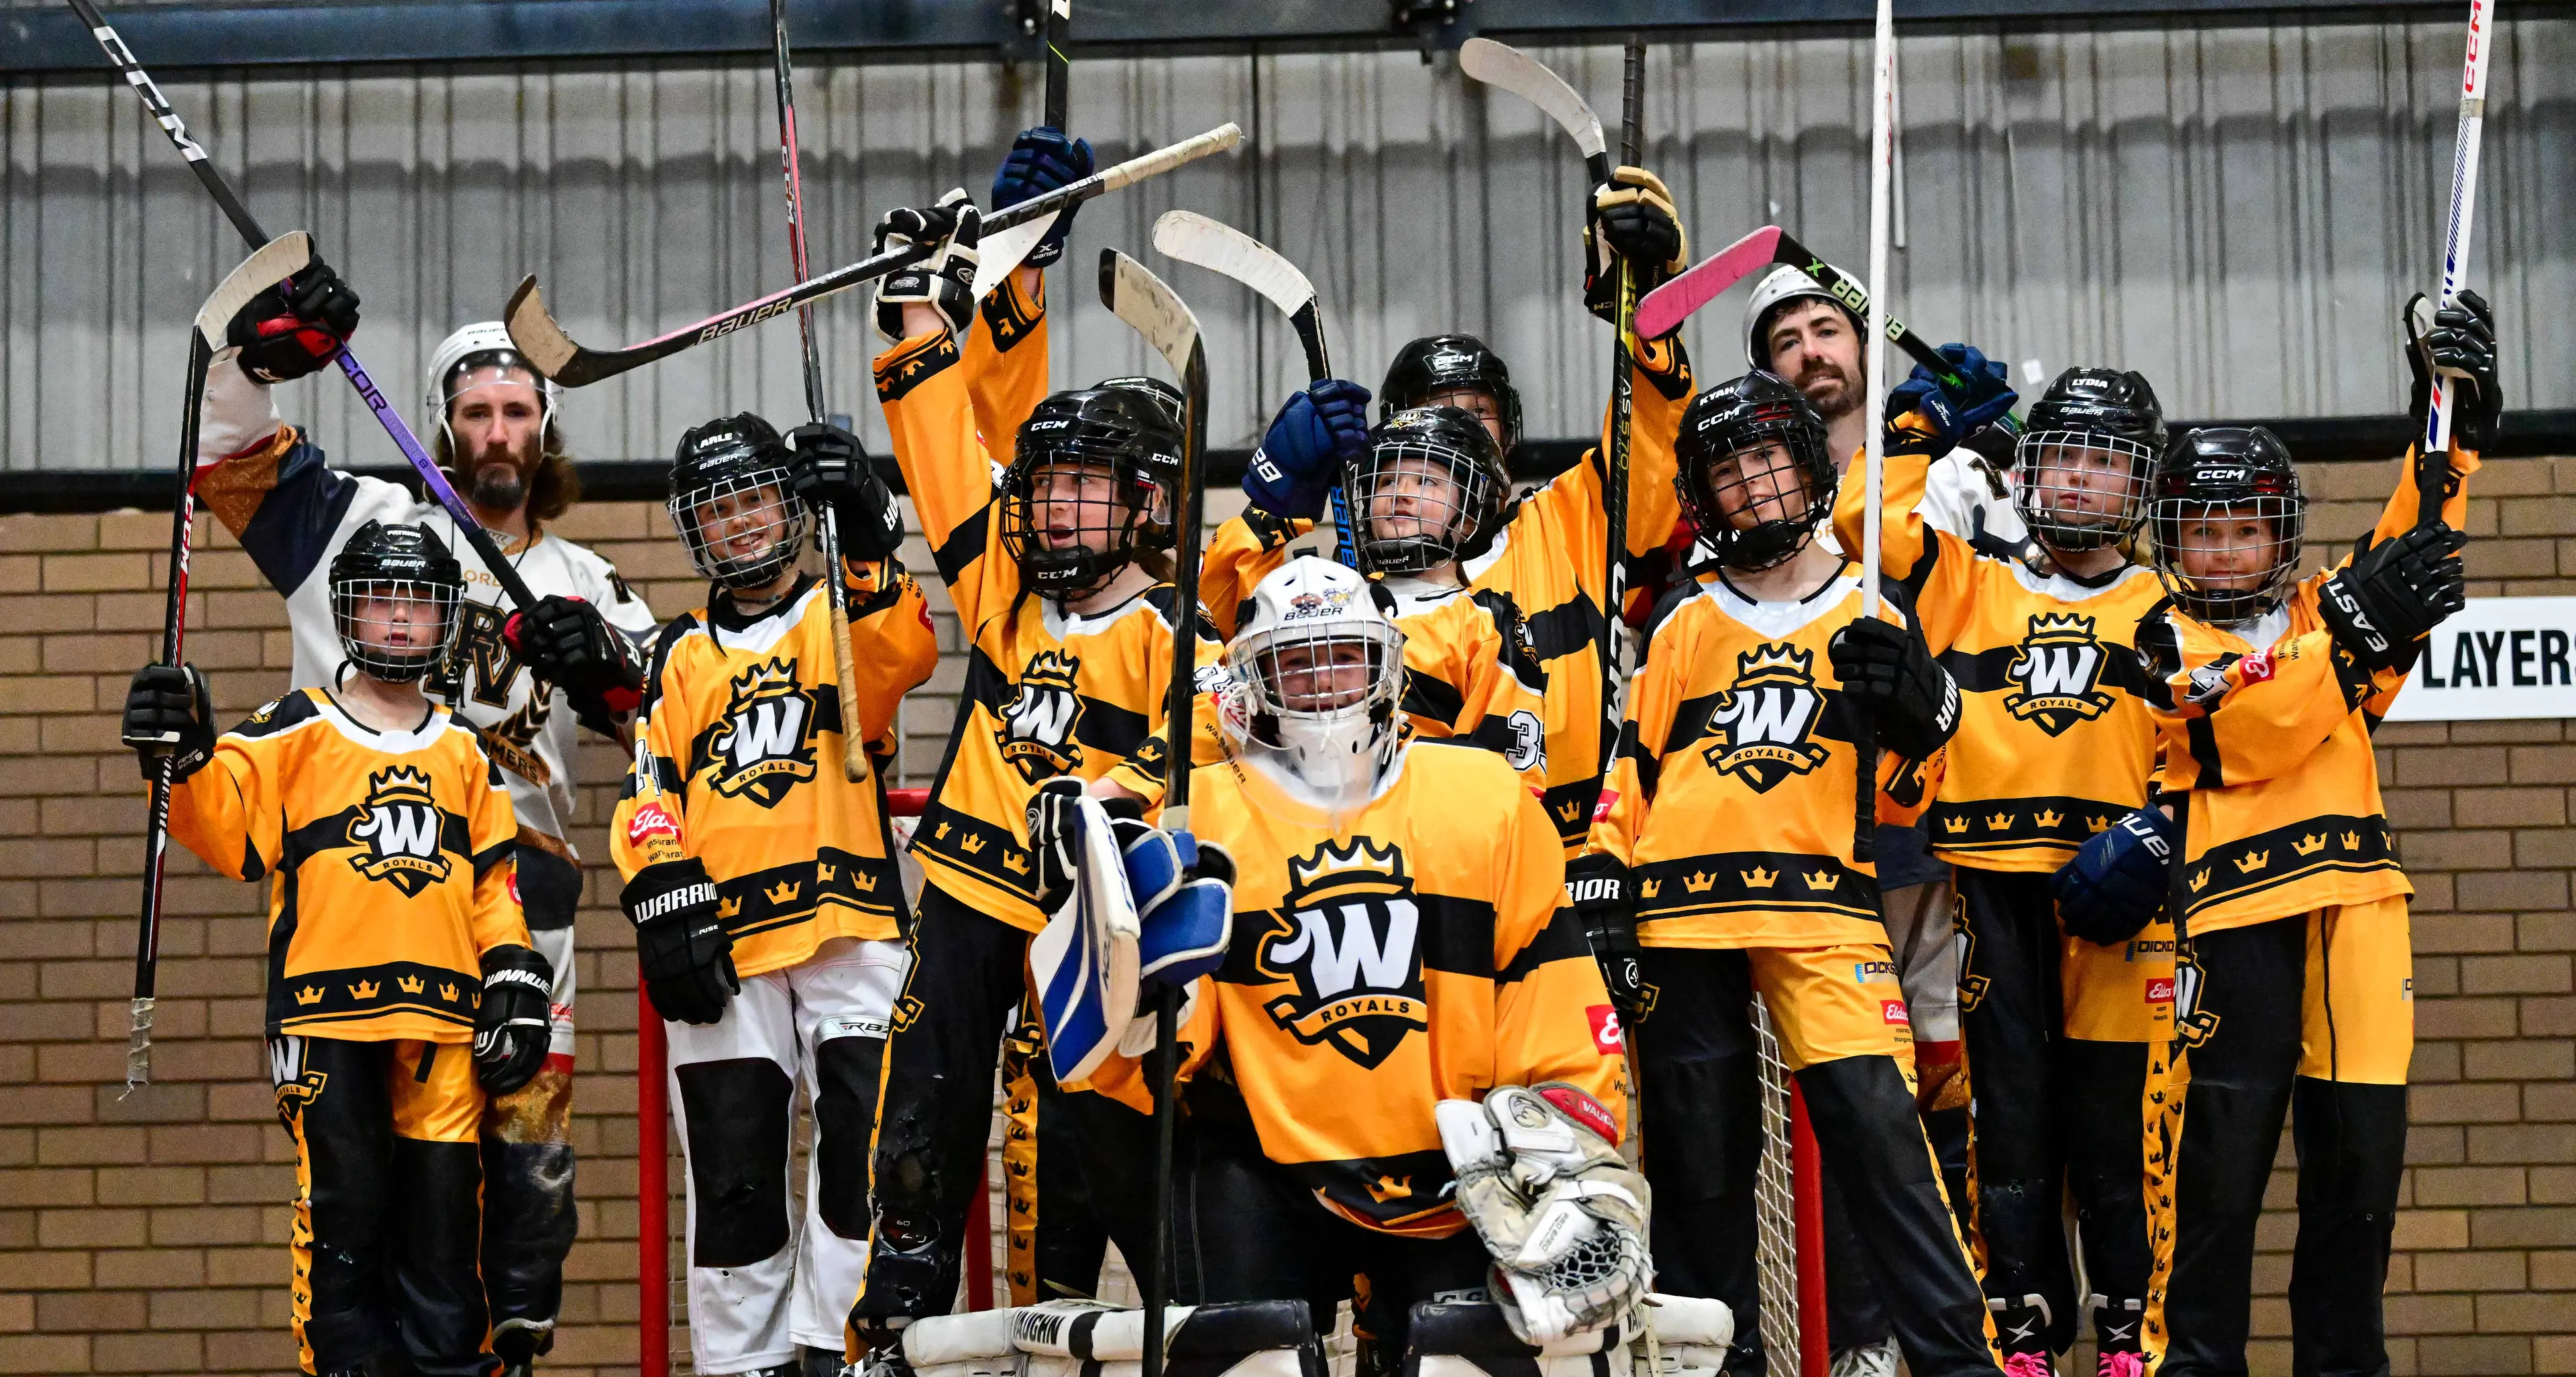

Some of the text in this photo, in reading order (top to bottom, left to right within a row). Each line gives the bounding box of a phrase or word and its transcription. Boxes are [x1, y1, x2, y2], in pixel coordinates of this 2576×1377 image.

[2464, 0, 2482, 93] CCM
[93, 25, 208, 162] CCM
[696, 296, 793, 347] BAUER
[2072, 378, 2108, 389] LYDIA
[1699, 386, 1735, 406] KYAH
[1697, 406, 1740, 432] CCM
[2059, 406, 2104, 417] BAUER
[1030, 420, 1069, 432] CCM
[1619, 377, 1632, 471] AS 570
[700, 433, 733, 449] ARLE
[699, 453, 739, 471] BAUER
[1152, 453, 1179, 466] CCM
[2196, 470, 2245, 480] CCM
[180, 493, 195, 575] CCM
[1330, 486, 1356, 568] AUER
[381, 558, 427, 569] BAUER
[1037, 566, 1079, 580] CCM
[1607, 561, 1626, 730] CCM
[2422, 630, 2576, 688] LAYER
[2012, 647, 2098, 696] W
[1006, 685, 1075, 747] W
[1713, 686, 1816, 747] W
[2030, 700, 2084, 710] ROYALS
[717, 696, 806, 768] W
[1505, 710, 1547, 773] 3
[178, 748, 199, 767] AMP
[1010, 745, 1056, 763] ROYALS
[1733, 749, 1796, 762] ROYALS
[739, 763, 796, 783] ROYALS
[354, 805, 437, 858] W
[383, 859, 433, 872] ROYALS
[634, 882, 718, 924] WARRIO
[698, 924, 719, 935] RISE
[1270, 898, 1419, 1001] W
[1864, 961, 1897, 975] DICKS
[484, 969, 551, 998] WINNWE
[1322, 1000, 1410, 1024] ROYALS
